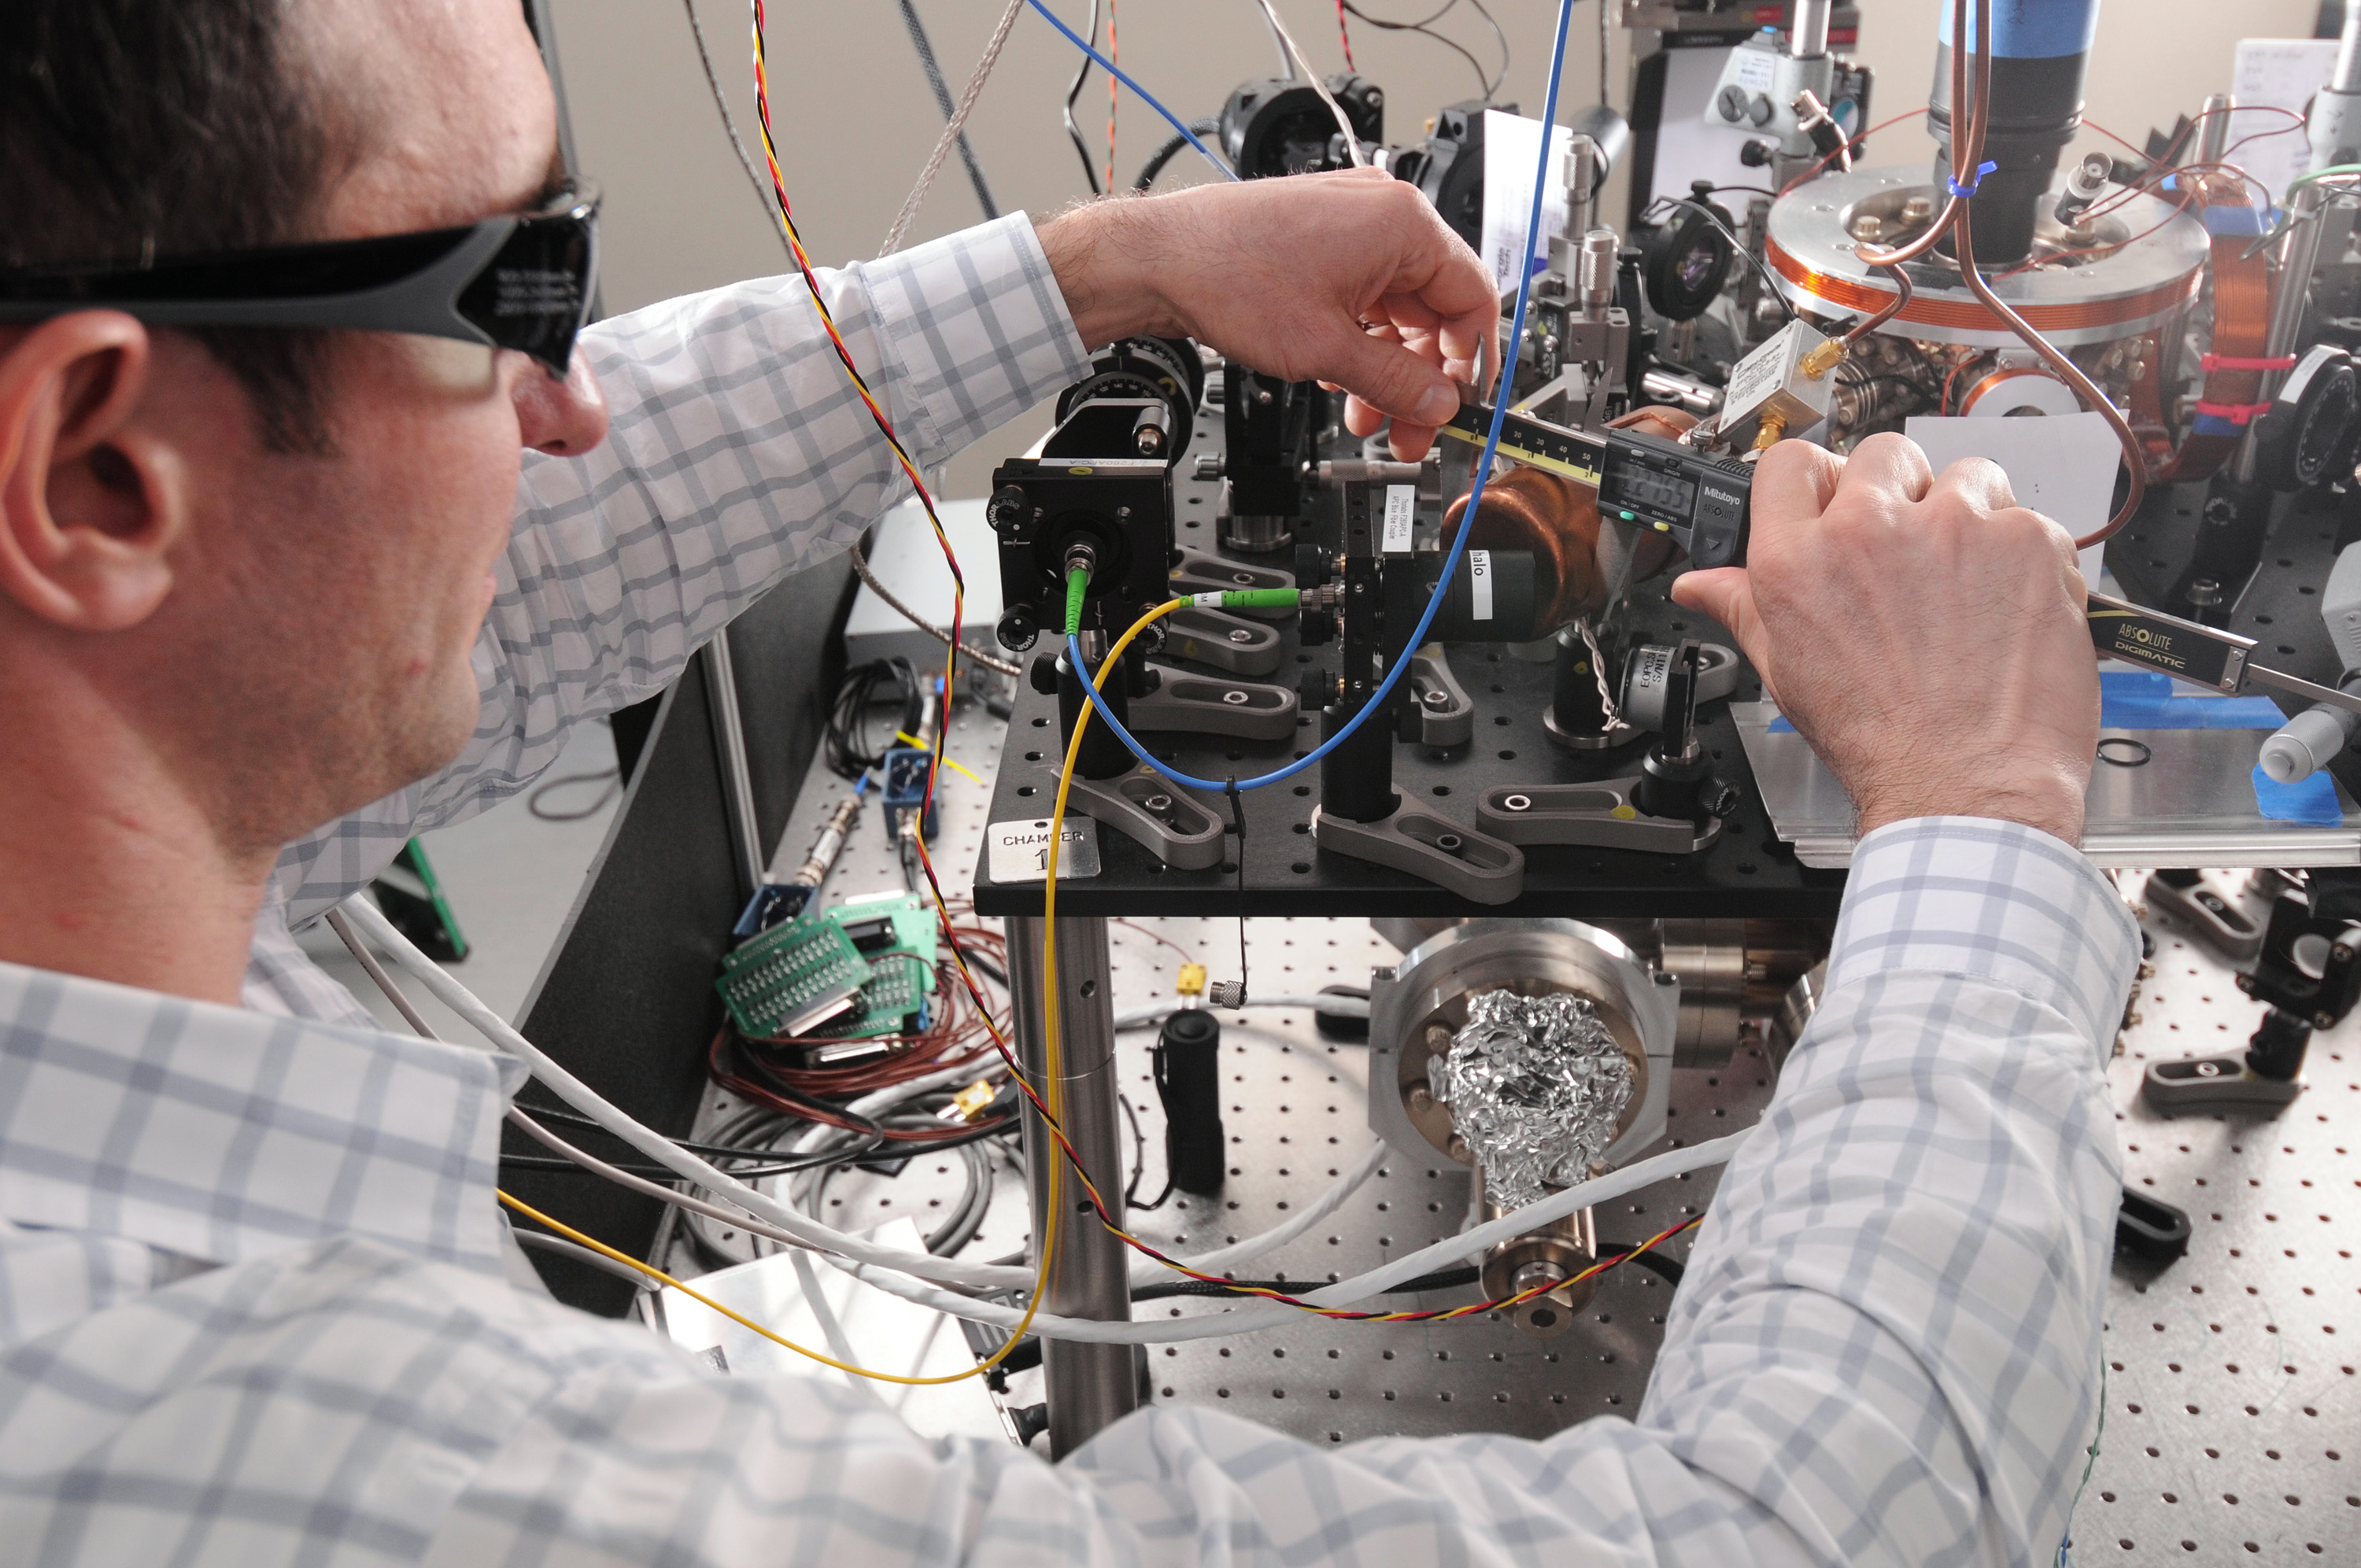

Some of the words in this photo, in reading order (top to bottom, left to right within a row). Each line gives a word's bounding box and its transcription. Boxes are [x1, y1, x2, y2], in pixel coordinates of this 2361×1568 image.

[1514, 430, 1522, 439] 20
[1582, 452, 1591, 461] 50
[1664, 468, 1681, 478] ORIGIN
[1400, 498, 1409, 514] Thorlabs
[1704, 486, 1741, 505] Mitutoyo
[988, 499, 1021, 527] THORLABS
[1703, 504, 1736, 521] ABSOLUTE
[1388, 525, 1398, 540] Coupler
[1472, 552, 1486, 576] halo
[999, 632, 1035, 651] THORLABS
[1145, 622, 1166, 655] THORLABS
[2118, 623, 2172, 650] ABSOLUTE
[2115, 641, 2186, 669] DIGIMATIC
[1003, 832, 1084, 847] CHAMER
[1035, 848, 1048, 871] 1
